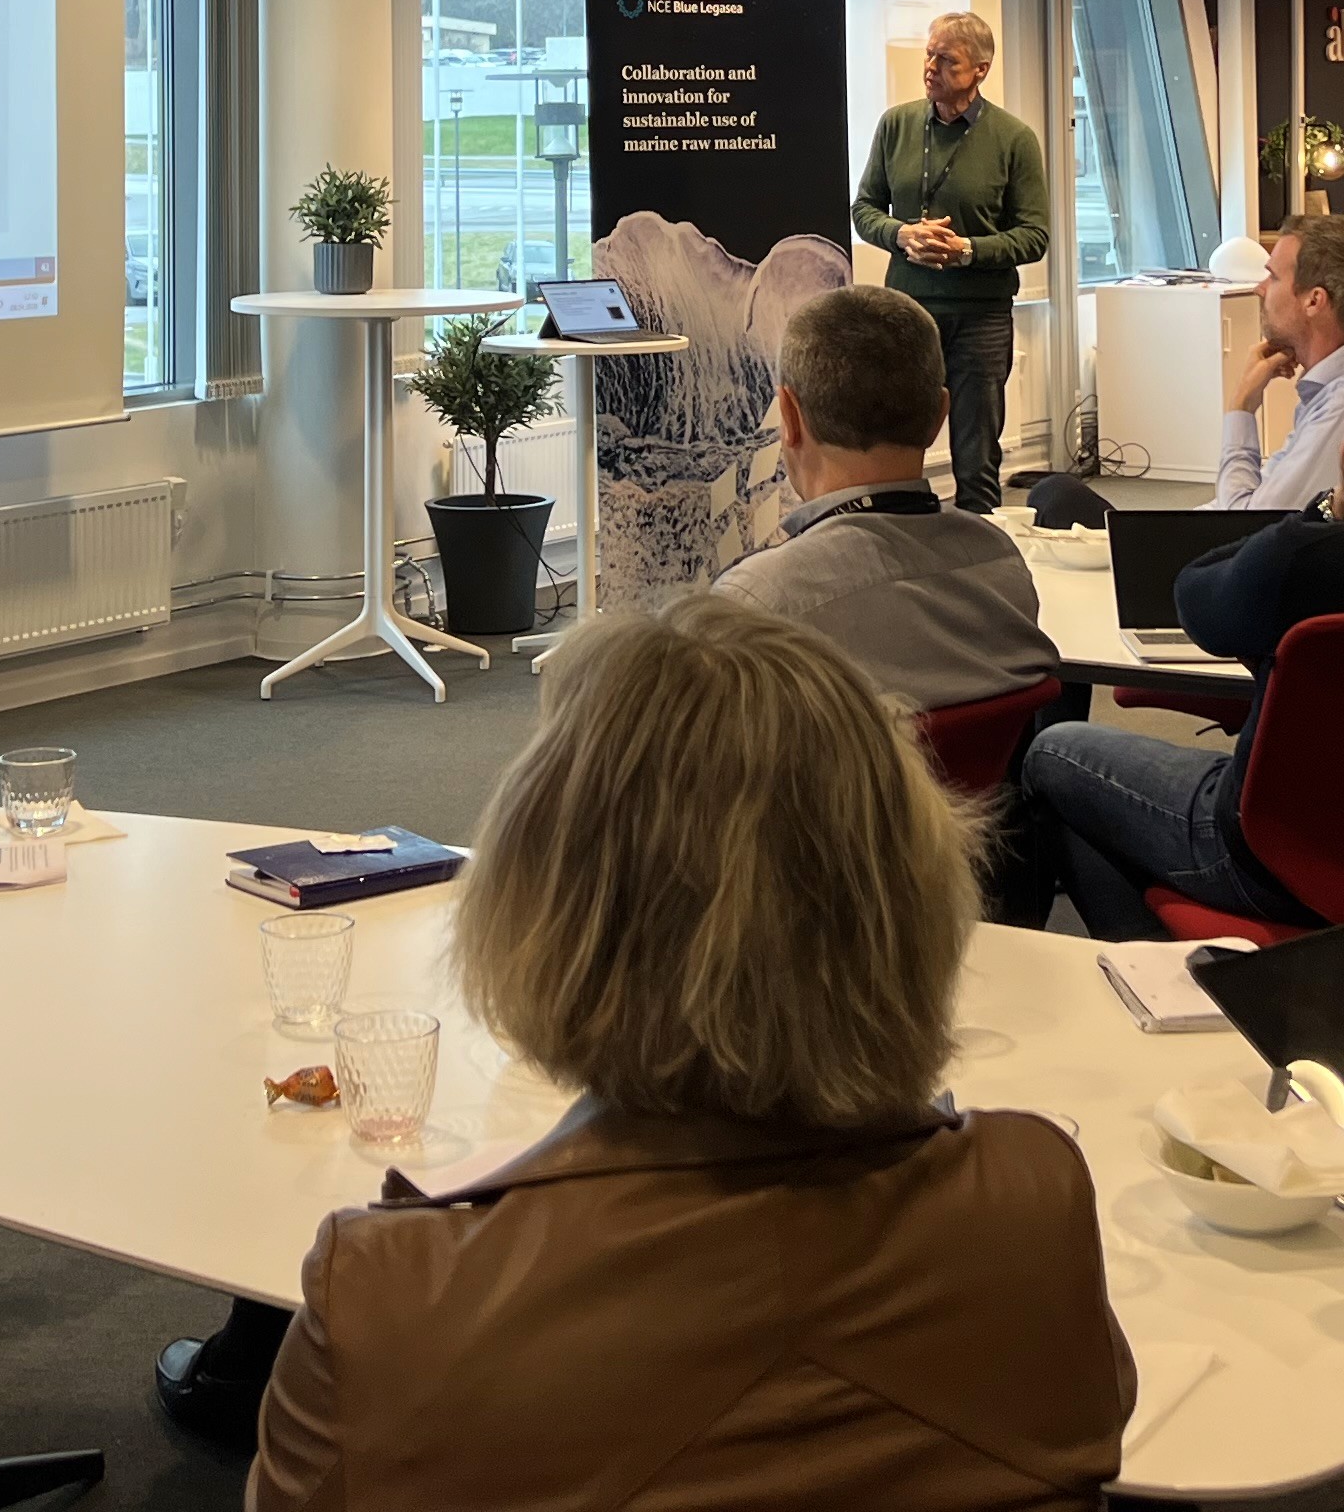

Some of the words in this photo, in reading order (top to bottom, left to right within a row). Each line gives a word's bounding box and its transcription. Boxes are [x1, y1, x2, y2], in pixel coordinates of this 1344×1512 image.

[647, 0, 672, 13] NCE
[673, 1, 698, 14] Blue
[700, 1, 744, 16] Legasea
[622, 64, 725, 81] Collaboration
[728, 65, 757, 81] and
[622, 88, 705, 104] innovation
[707, 88, 731, 104] for
[623, 111, 709, 128] sustainable
[711, 115, 738, 127] use
[740, 111, 757, 127] of
[623, 136, 679, 152] marine
[682, 138, 711, 151] raw
[714, 134, 777, 150] material
